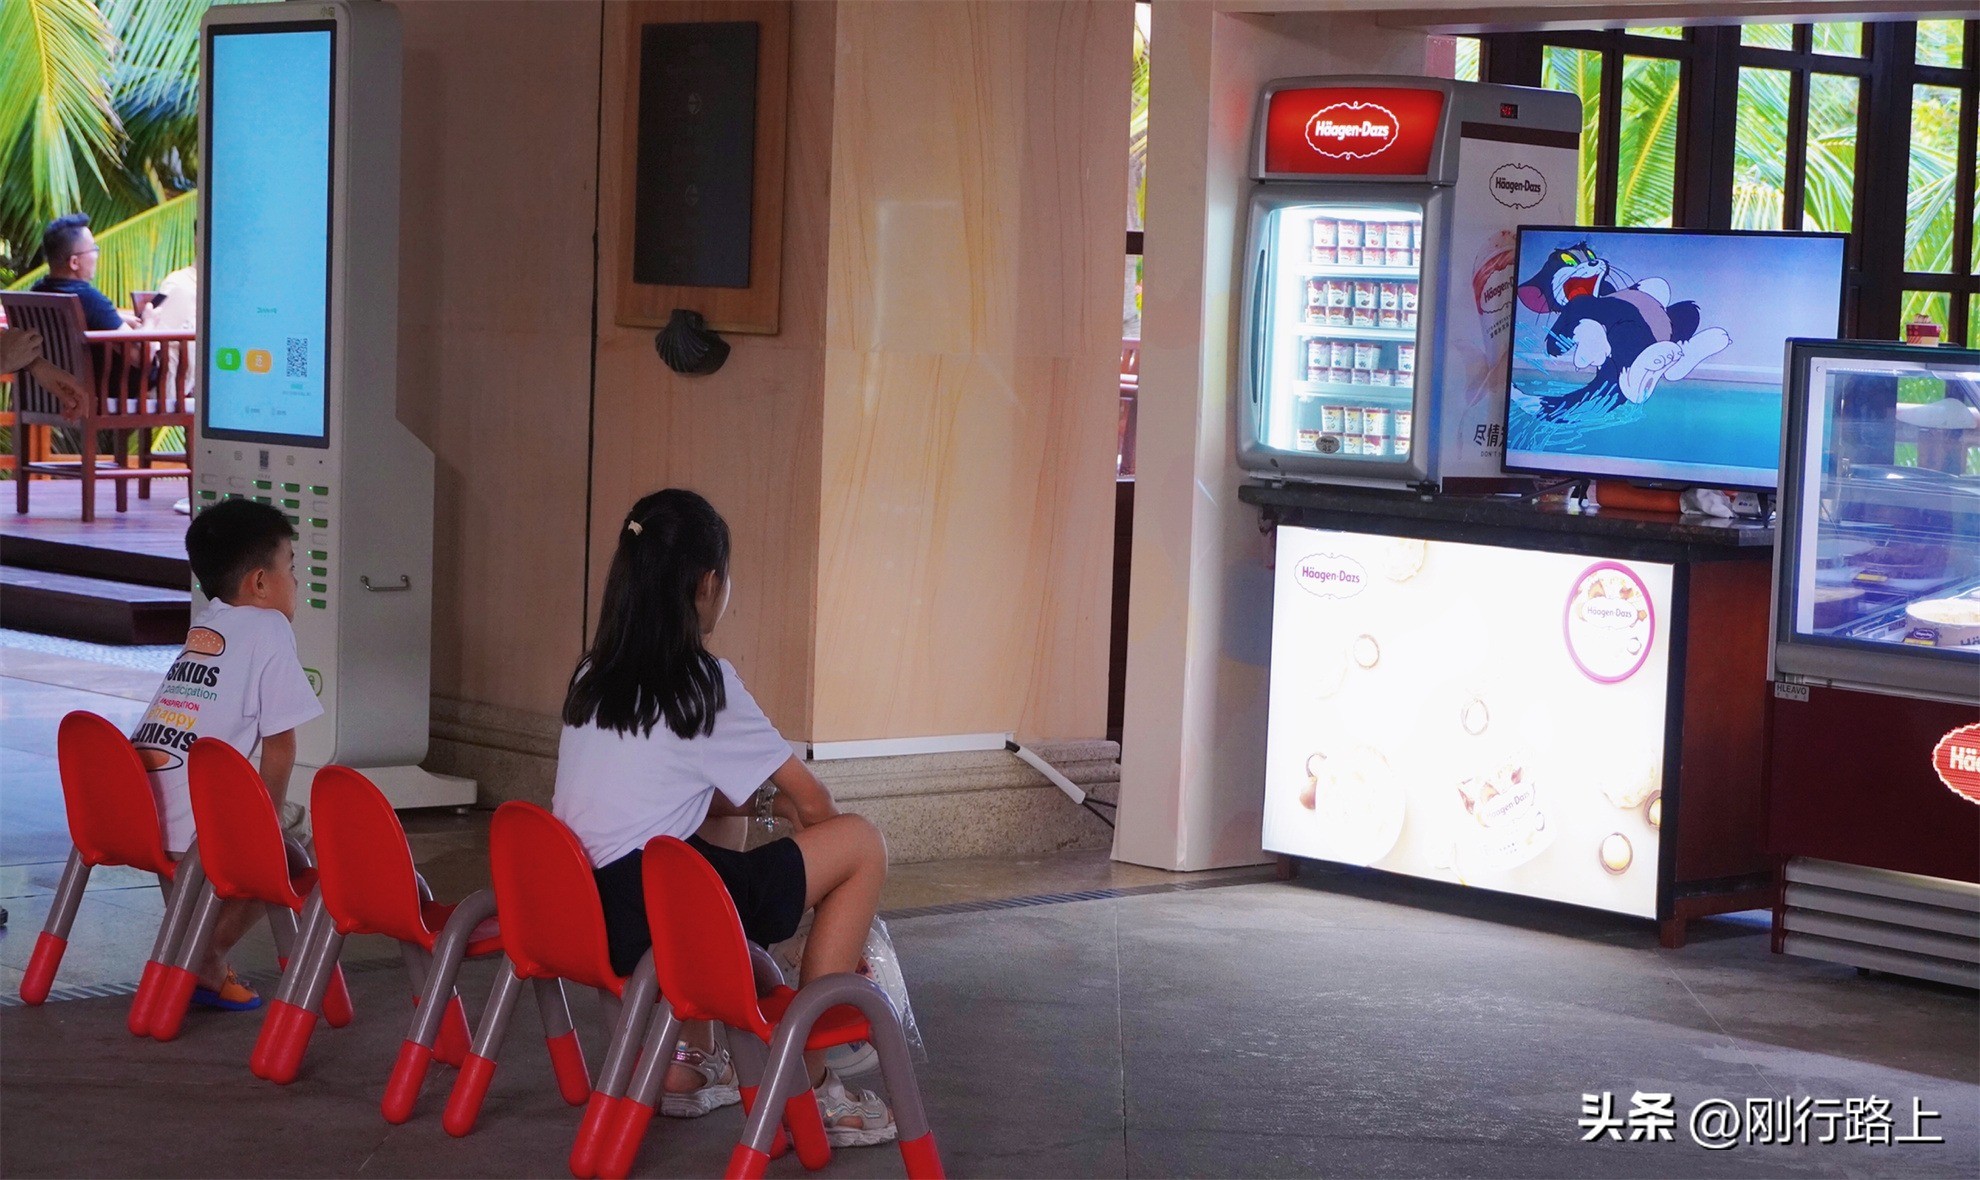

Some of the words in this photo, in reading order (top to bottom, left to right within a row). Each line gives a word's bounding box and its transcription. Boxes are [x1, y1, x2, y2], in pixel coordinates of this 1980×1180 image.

[1315, 120, 1389, 141] Häagen-Dazs
[1495, 176, 1541, 194] Häagen-Dazs
[1484, 276, 1515, 303] Häagen-D
[1302, 566, 1360, 583] Häagen-Dazs
[160, 698, 200, 711] INSPIRATION
